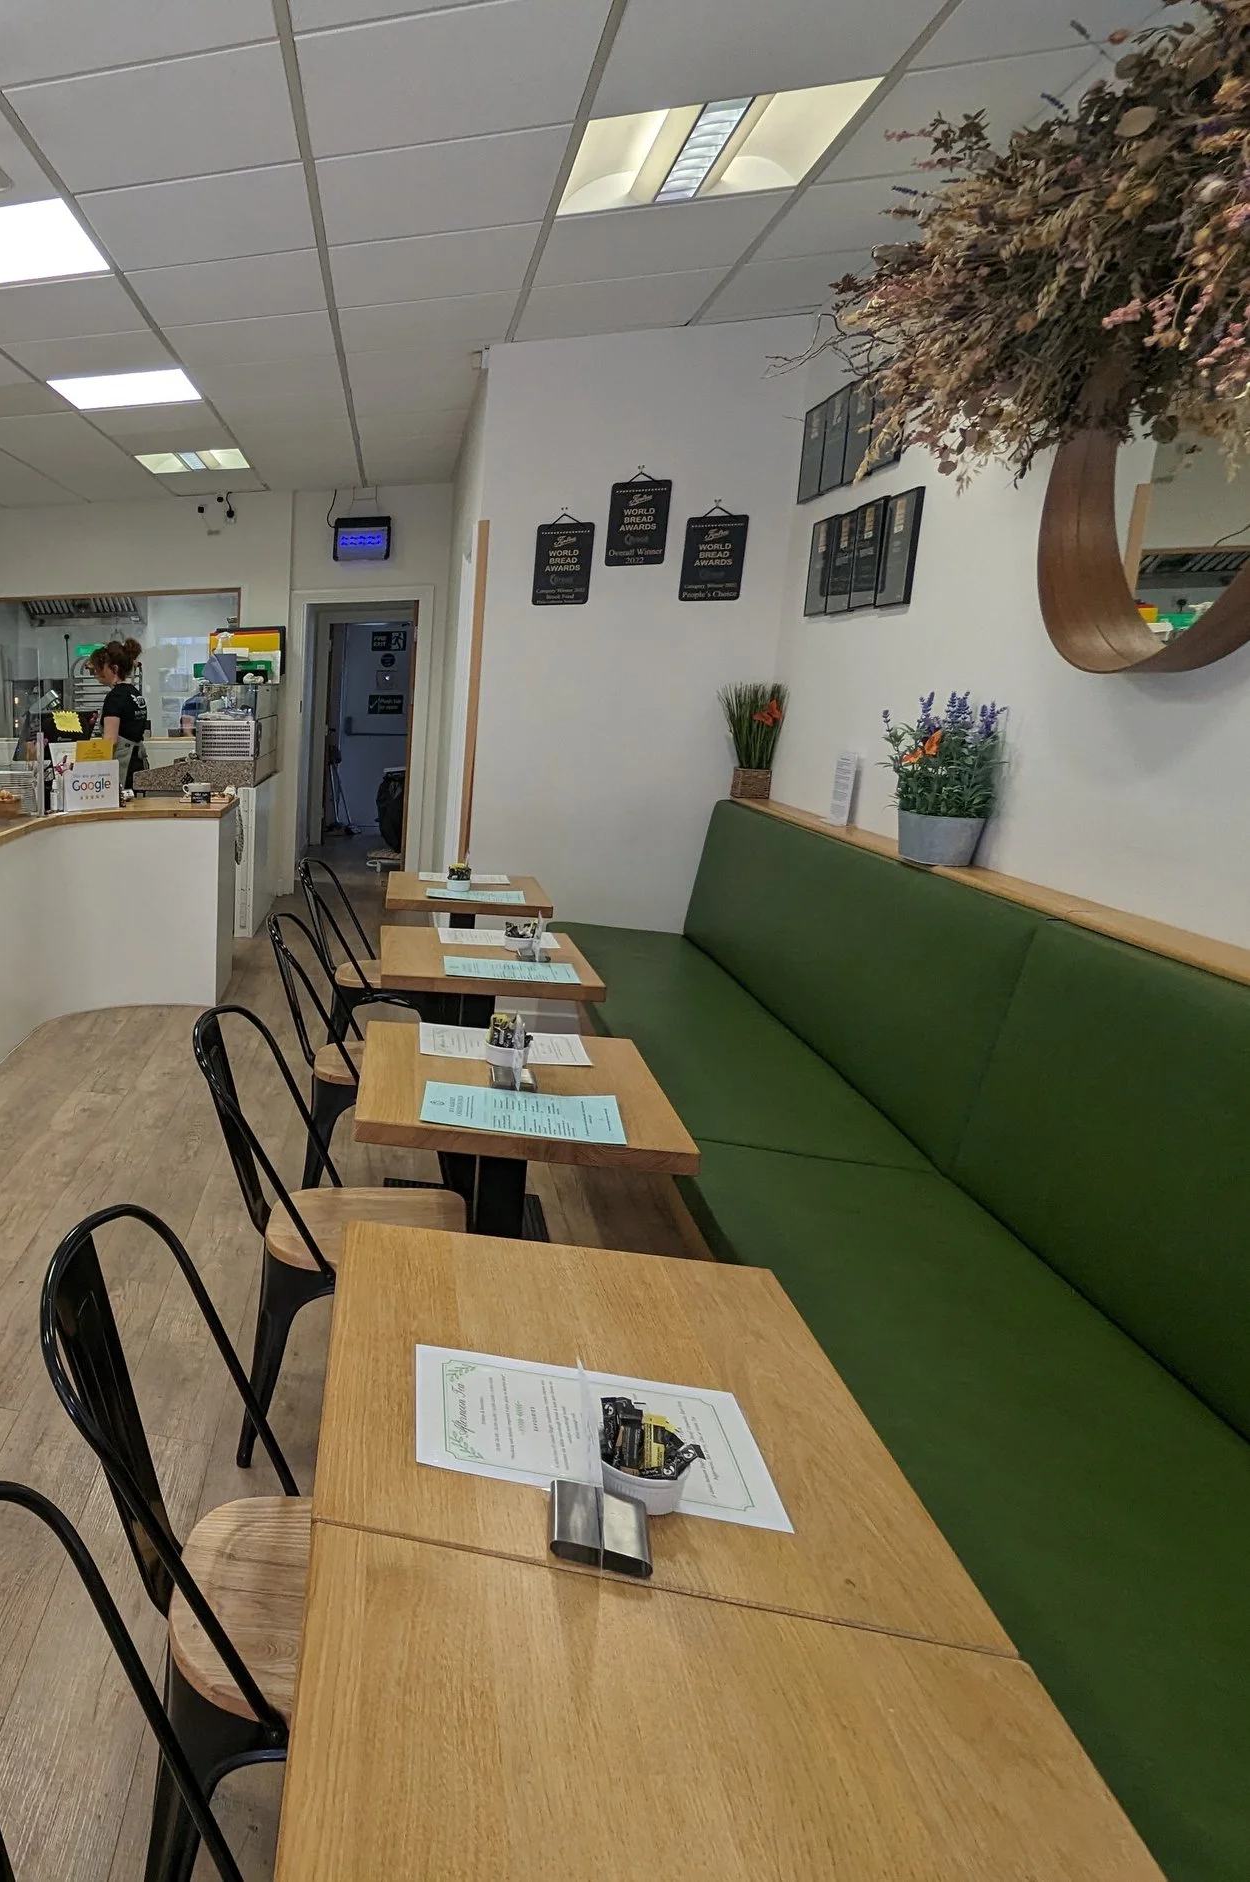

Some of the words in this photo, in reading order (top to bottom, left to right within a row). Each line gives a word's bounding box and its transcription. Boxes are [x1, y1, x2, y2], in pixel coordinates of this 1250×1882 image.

[623, 508, 655, 516] WORLD
[619, 523, 657, 531] AWARDS
[548, 549, 579, 557] WORLD
[544, 564, 581, 572] AWARDS
[72, 778, 111, 793] Google
[451, 1383, 467, 1398] Tea
[449, 1398, 476, 1438] Afternoon
